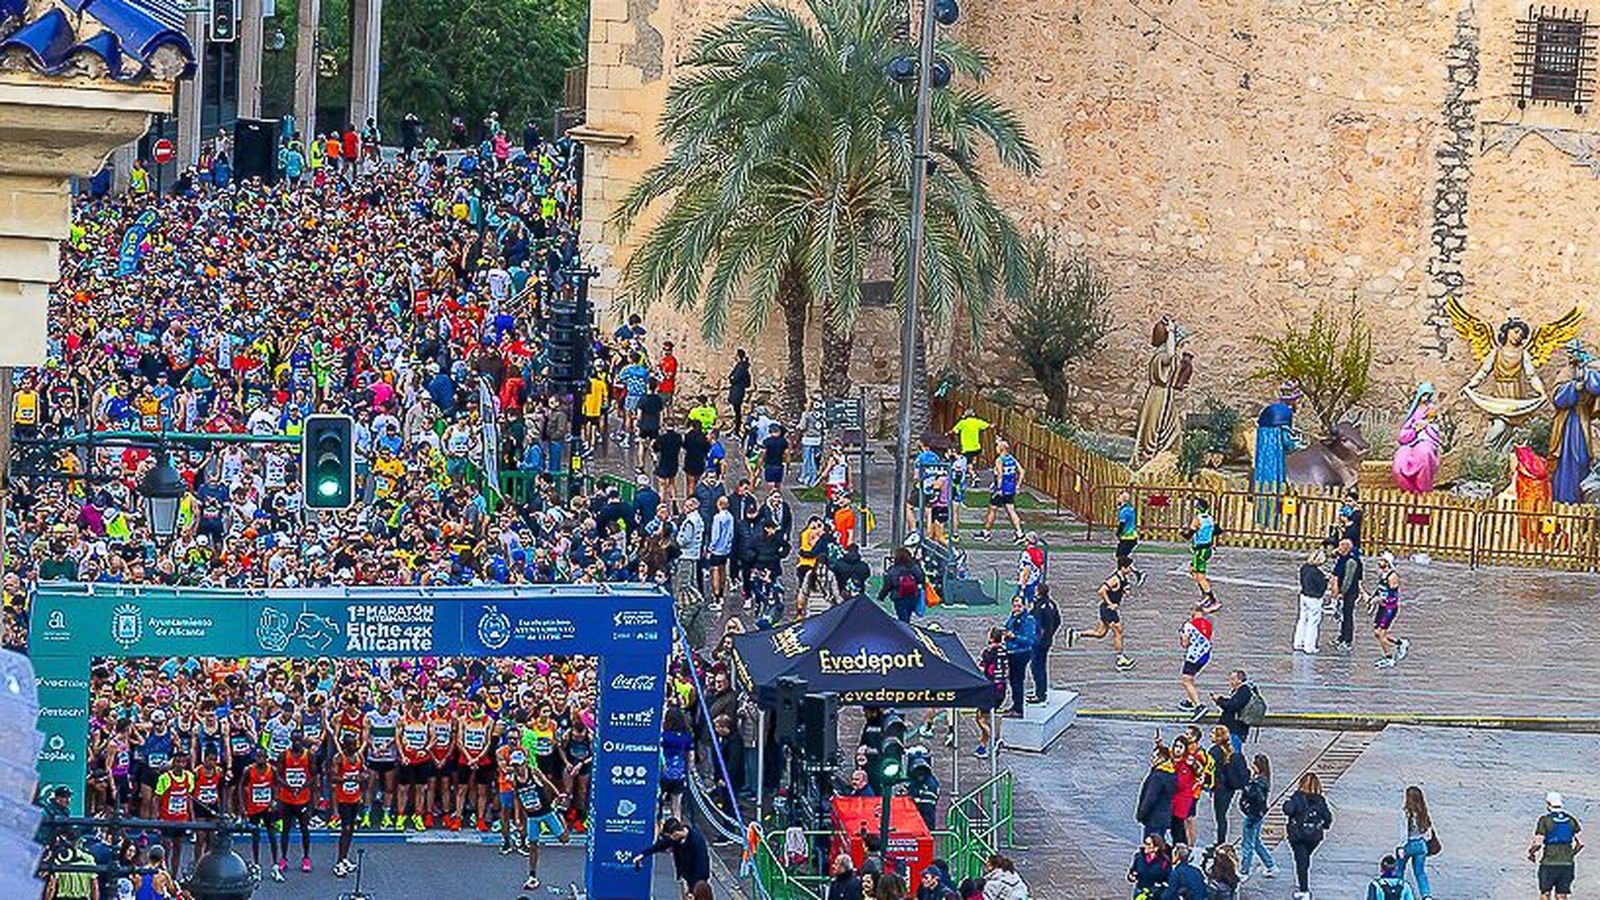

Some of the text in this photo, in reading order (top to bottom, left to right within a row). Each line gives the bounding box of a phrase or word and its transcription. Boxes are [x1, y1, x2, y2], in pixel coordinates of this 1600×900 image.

[148, 617, 213, 629] Ayuntamiento
[346, 622, 402, 638] Elche
[346, 636, 433, 652] Alicante
[818, 648, 925, 675] Evedeport
[837, 686, 958, 702] .evedeport.es
